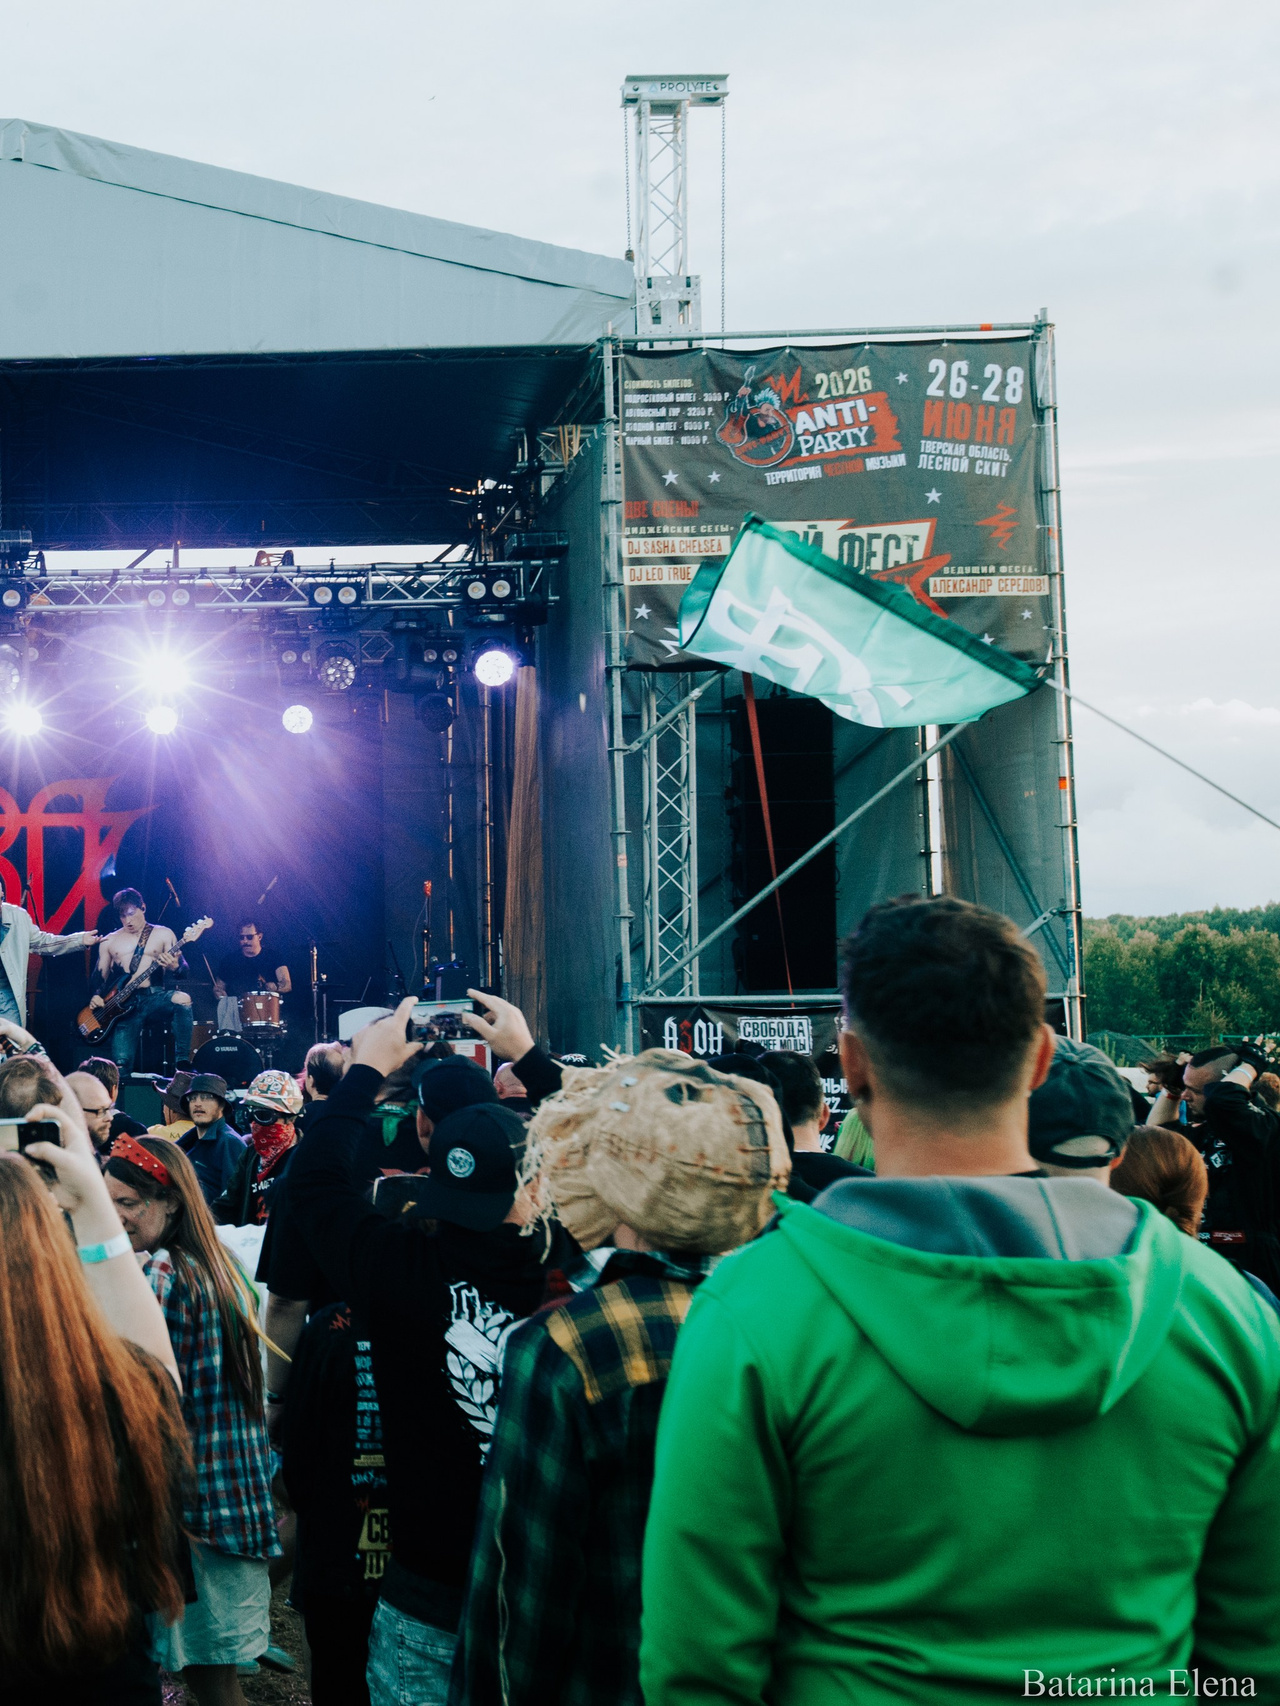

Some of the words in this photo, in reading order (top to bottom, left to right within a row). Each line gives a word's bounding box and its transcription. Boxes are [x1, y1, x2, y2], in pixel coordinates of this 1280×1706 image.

[661, 82, 711, 91] PROLYTE
[815, 365, 872, 399] 2026
[926, 359, 1024, 404] 26-28
[675, 393, 696, 402] БИЛЕТ
[724, 392, 731, 401] Р.
[668, 407, 680, 416] ТУР
[687, 407, 706, 416] 3200
[707, 407, 715, 416] Р.
[795, 399, 877, 435] ANTI-
[656, 422, 677, 431] БИЛЕТ
[704, 421, 711, 430] Р.
[922, 399, 1017, 446] ИЮНЯ
[653, 436, 674, 445] БИЛЕТ
[702, 436, 710, 444] Р.
[797, 426, 869, 457] PARTY
[920, 440, 966, 456] ТВЕРСКАЯ
[764, 465, 822, 485] ТЕРРИТОРИЯ
[865, 453, 906, 471] МУЗЫКИ
[917, 454, 970, 473] ЛЕСНОЙ
[975, 460, 1008, 478] СКИТ
[625, 500, 649, 519] ДВЕ
[624, 525, 697, 535] ДИДЖЕЙСКИЕ
[627, 541, 641, 555] DJ
[643, 540, 676, 554] SASHA
[679, 539, 722, 553] CHELSEA
[629, 568, 642, 582] DJ
[645, 567, 663, 581] LEO
[668, 566, 692, 581] TRUE
[943, 565, 996, 574] ВЕДУЩИЙ
[932, 579, 993, 593] АЛЕКСАНДР
[998, 578, 1046, 593] СЕРЕДОВ!
[743, 1021, 805, 1039] СВОБОДА
